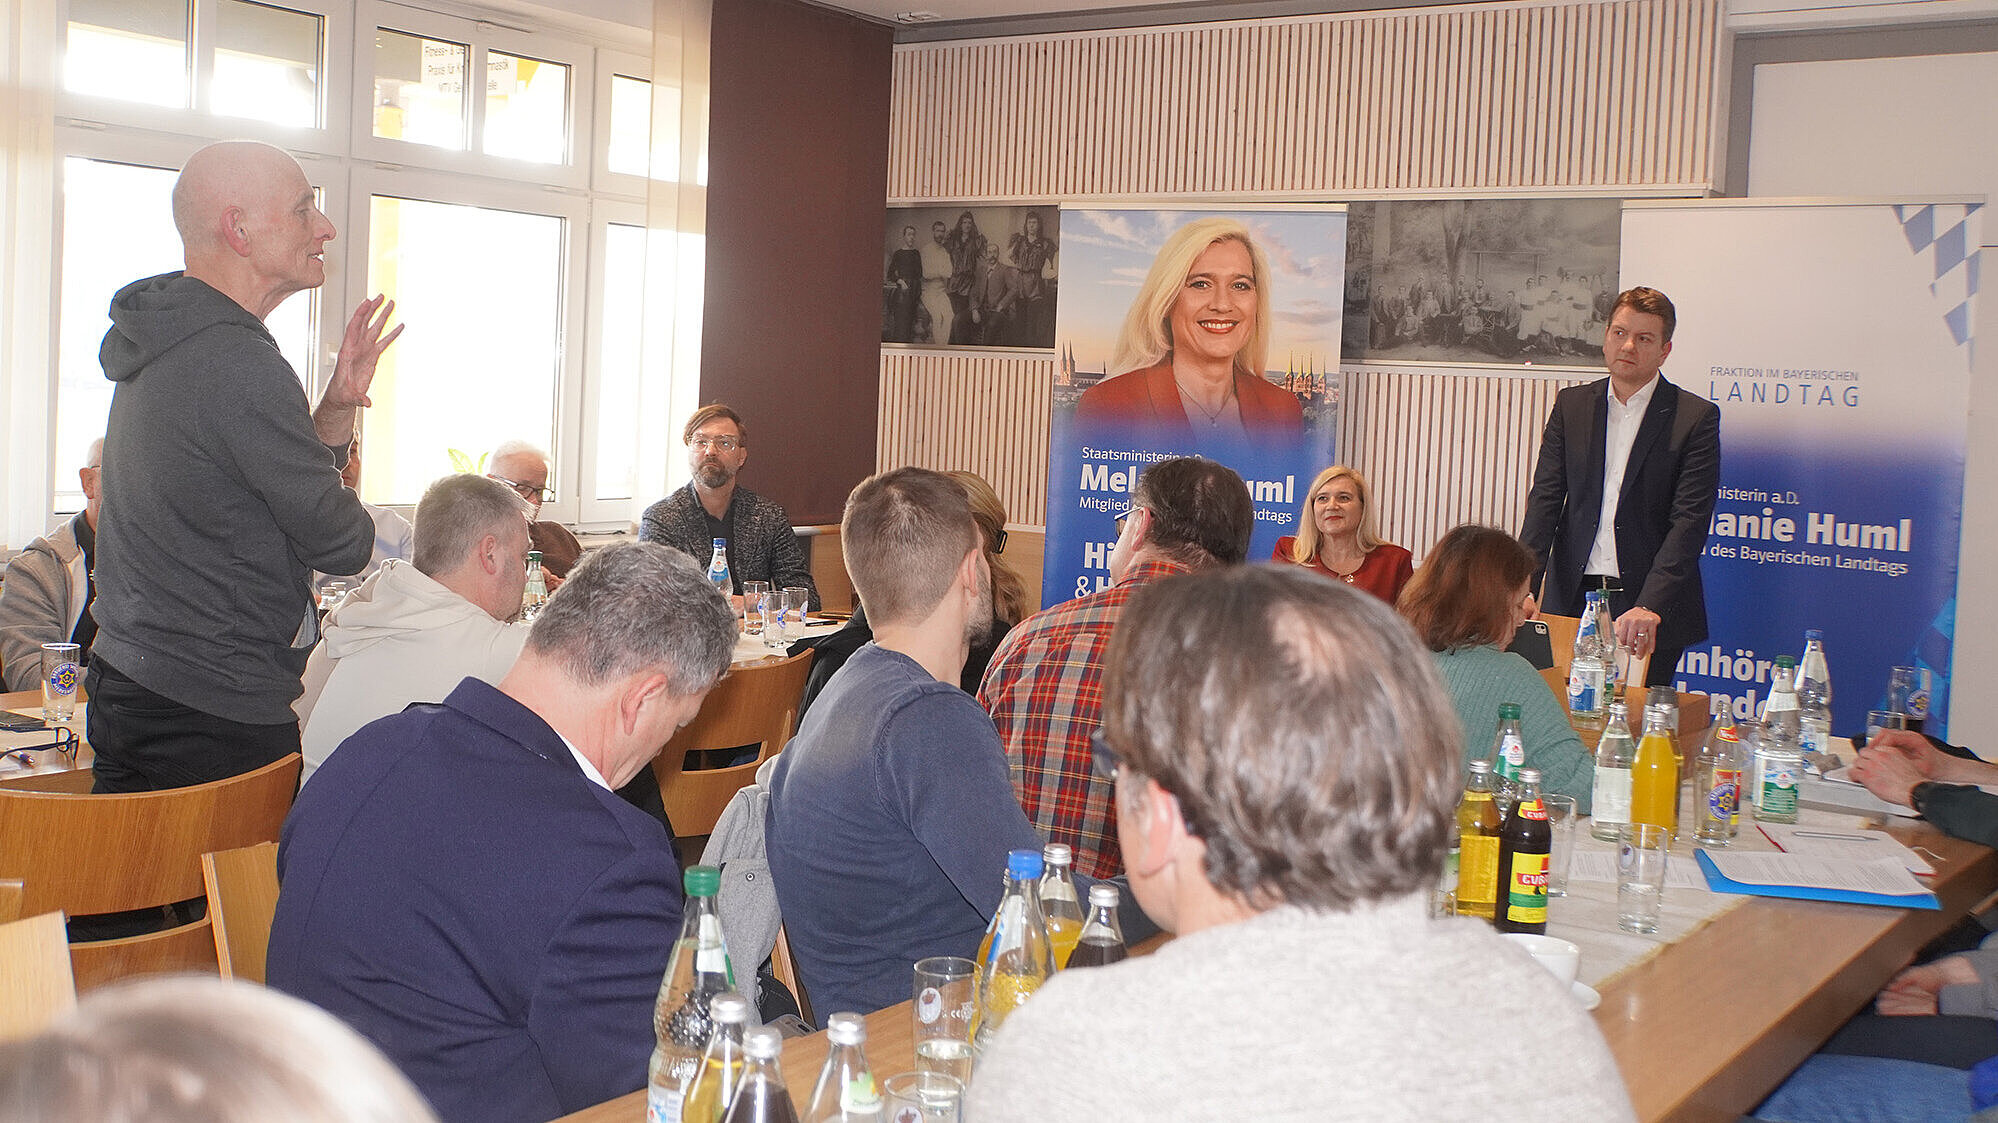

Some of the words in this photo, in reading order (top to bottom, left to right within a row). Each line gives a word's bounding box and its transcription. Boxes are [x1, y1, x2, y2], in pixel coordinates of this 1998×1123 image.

[1710, 366, 1763, 378] FRAKTION
[1766, 368, 1779, 378] IM
[1783, 369, 1859, 381] BAYERISCHEN
[1710, 380, 1859, 407] LANDTAG
[1079, 496, 1130, 513] Mitglied
[1771, 490, 1800, 505] a.D.
[1806, 512, 1912, 552] Huml
[1710, 543, 1736, 559] des
[1740, 545, 1831, 567] Bayerischen
[1835, 554, 1909, 577] Landtags
[1075, 575, 1091, 599] &
